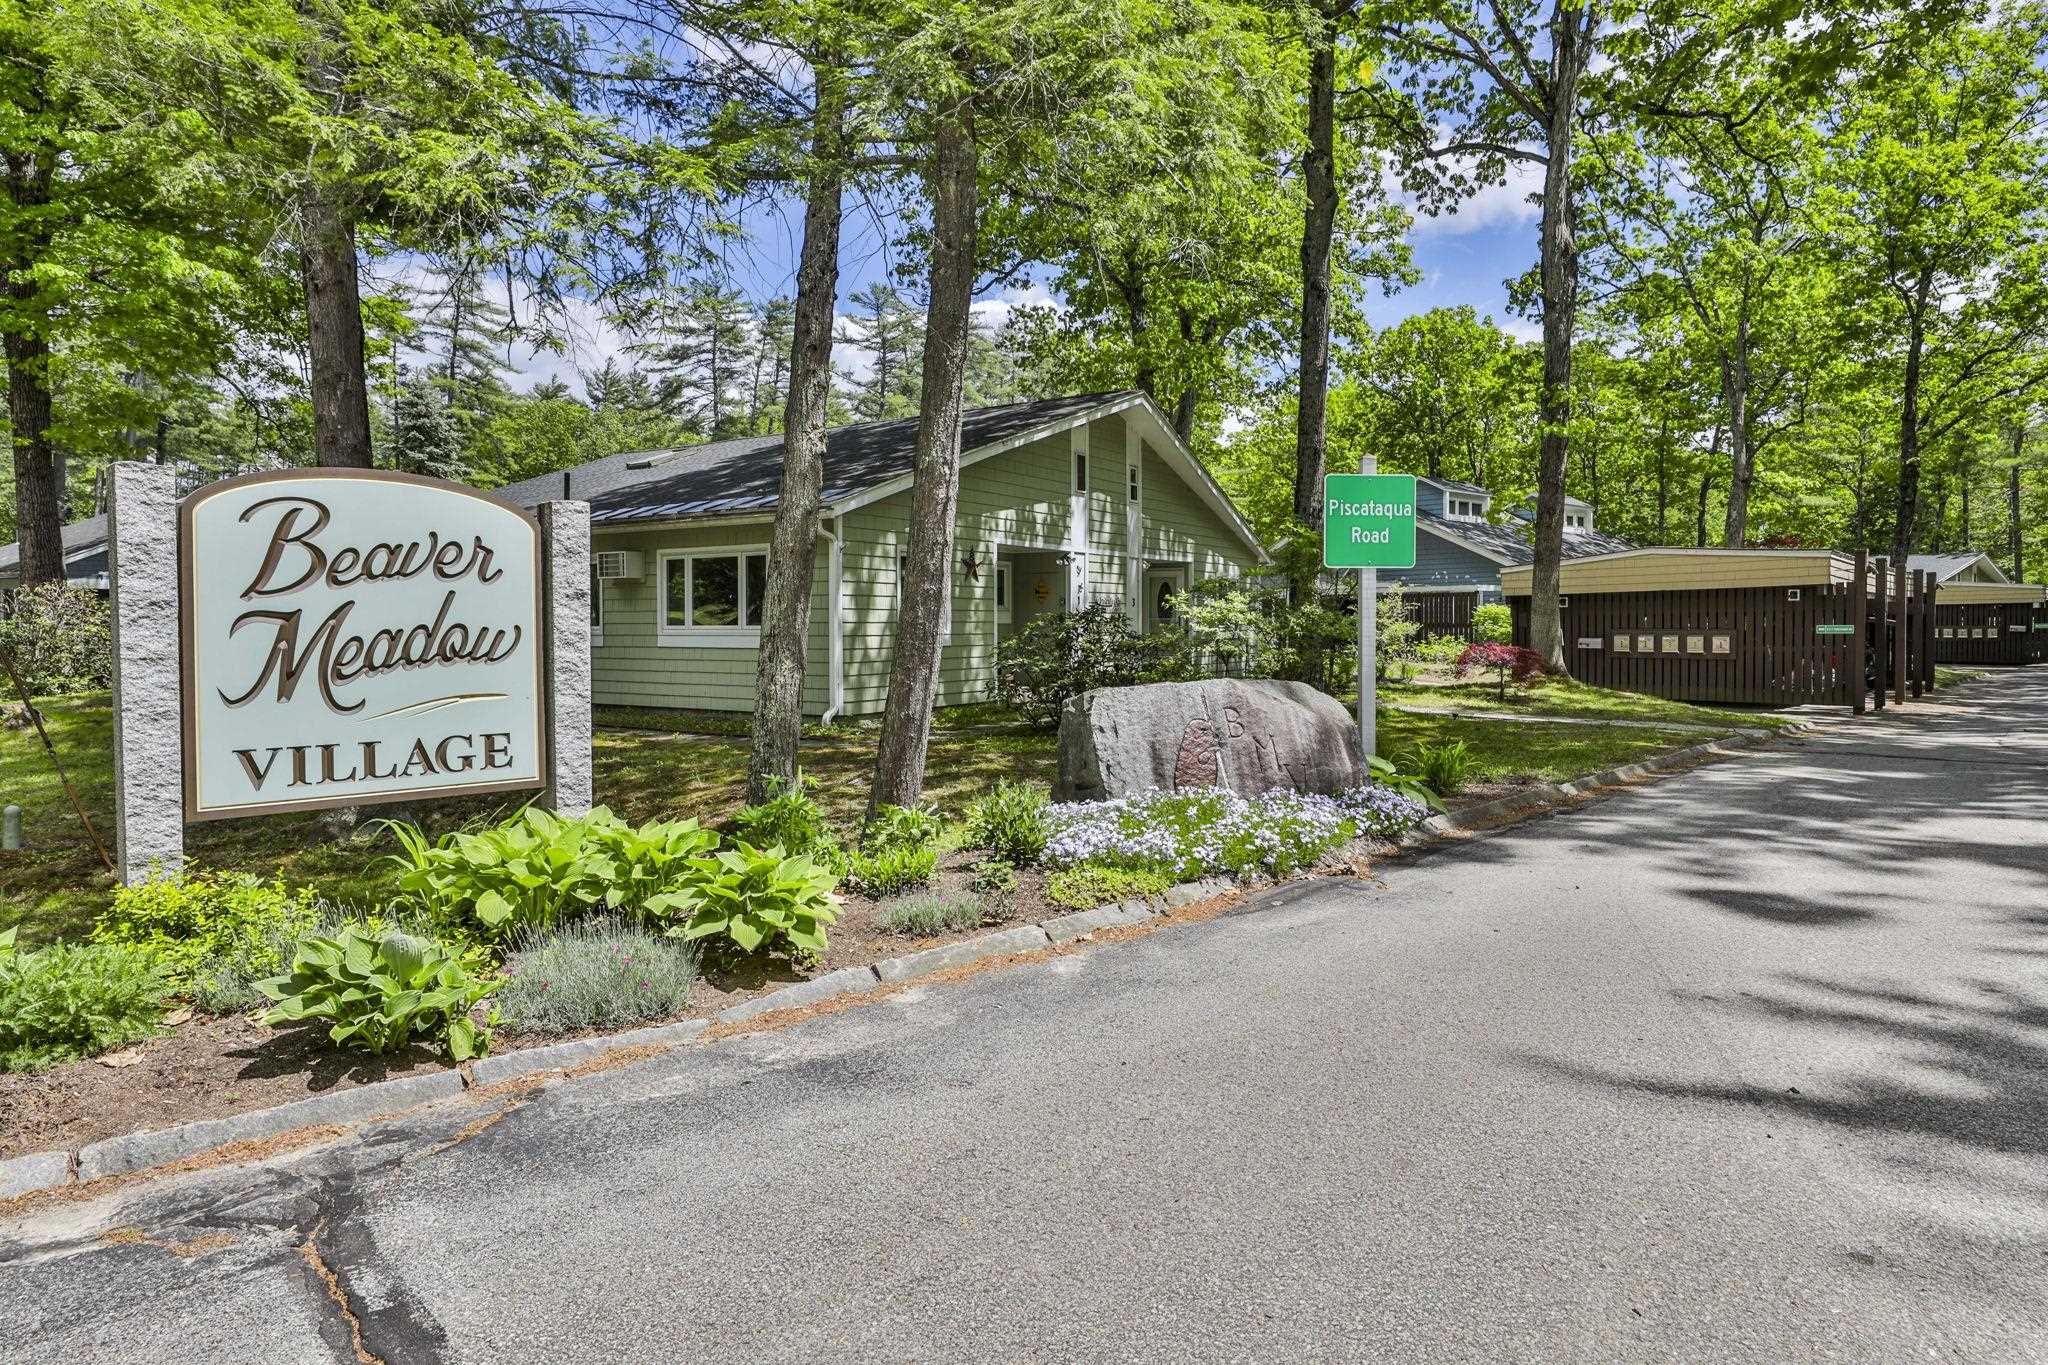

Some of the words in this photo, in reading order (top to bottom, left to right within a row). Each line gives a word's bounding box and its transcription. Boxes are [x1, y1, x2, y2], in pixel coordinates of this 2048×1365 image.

[1328, 499, 1412, 520] Piscataqua
[1351, 526, 1389, 543] Road
[238, 495, 504, 601] Beaver
[216, 590, 522, 716] Meadow
[232, 732, 513, 792] VILLAGE
